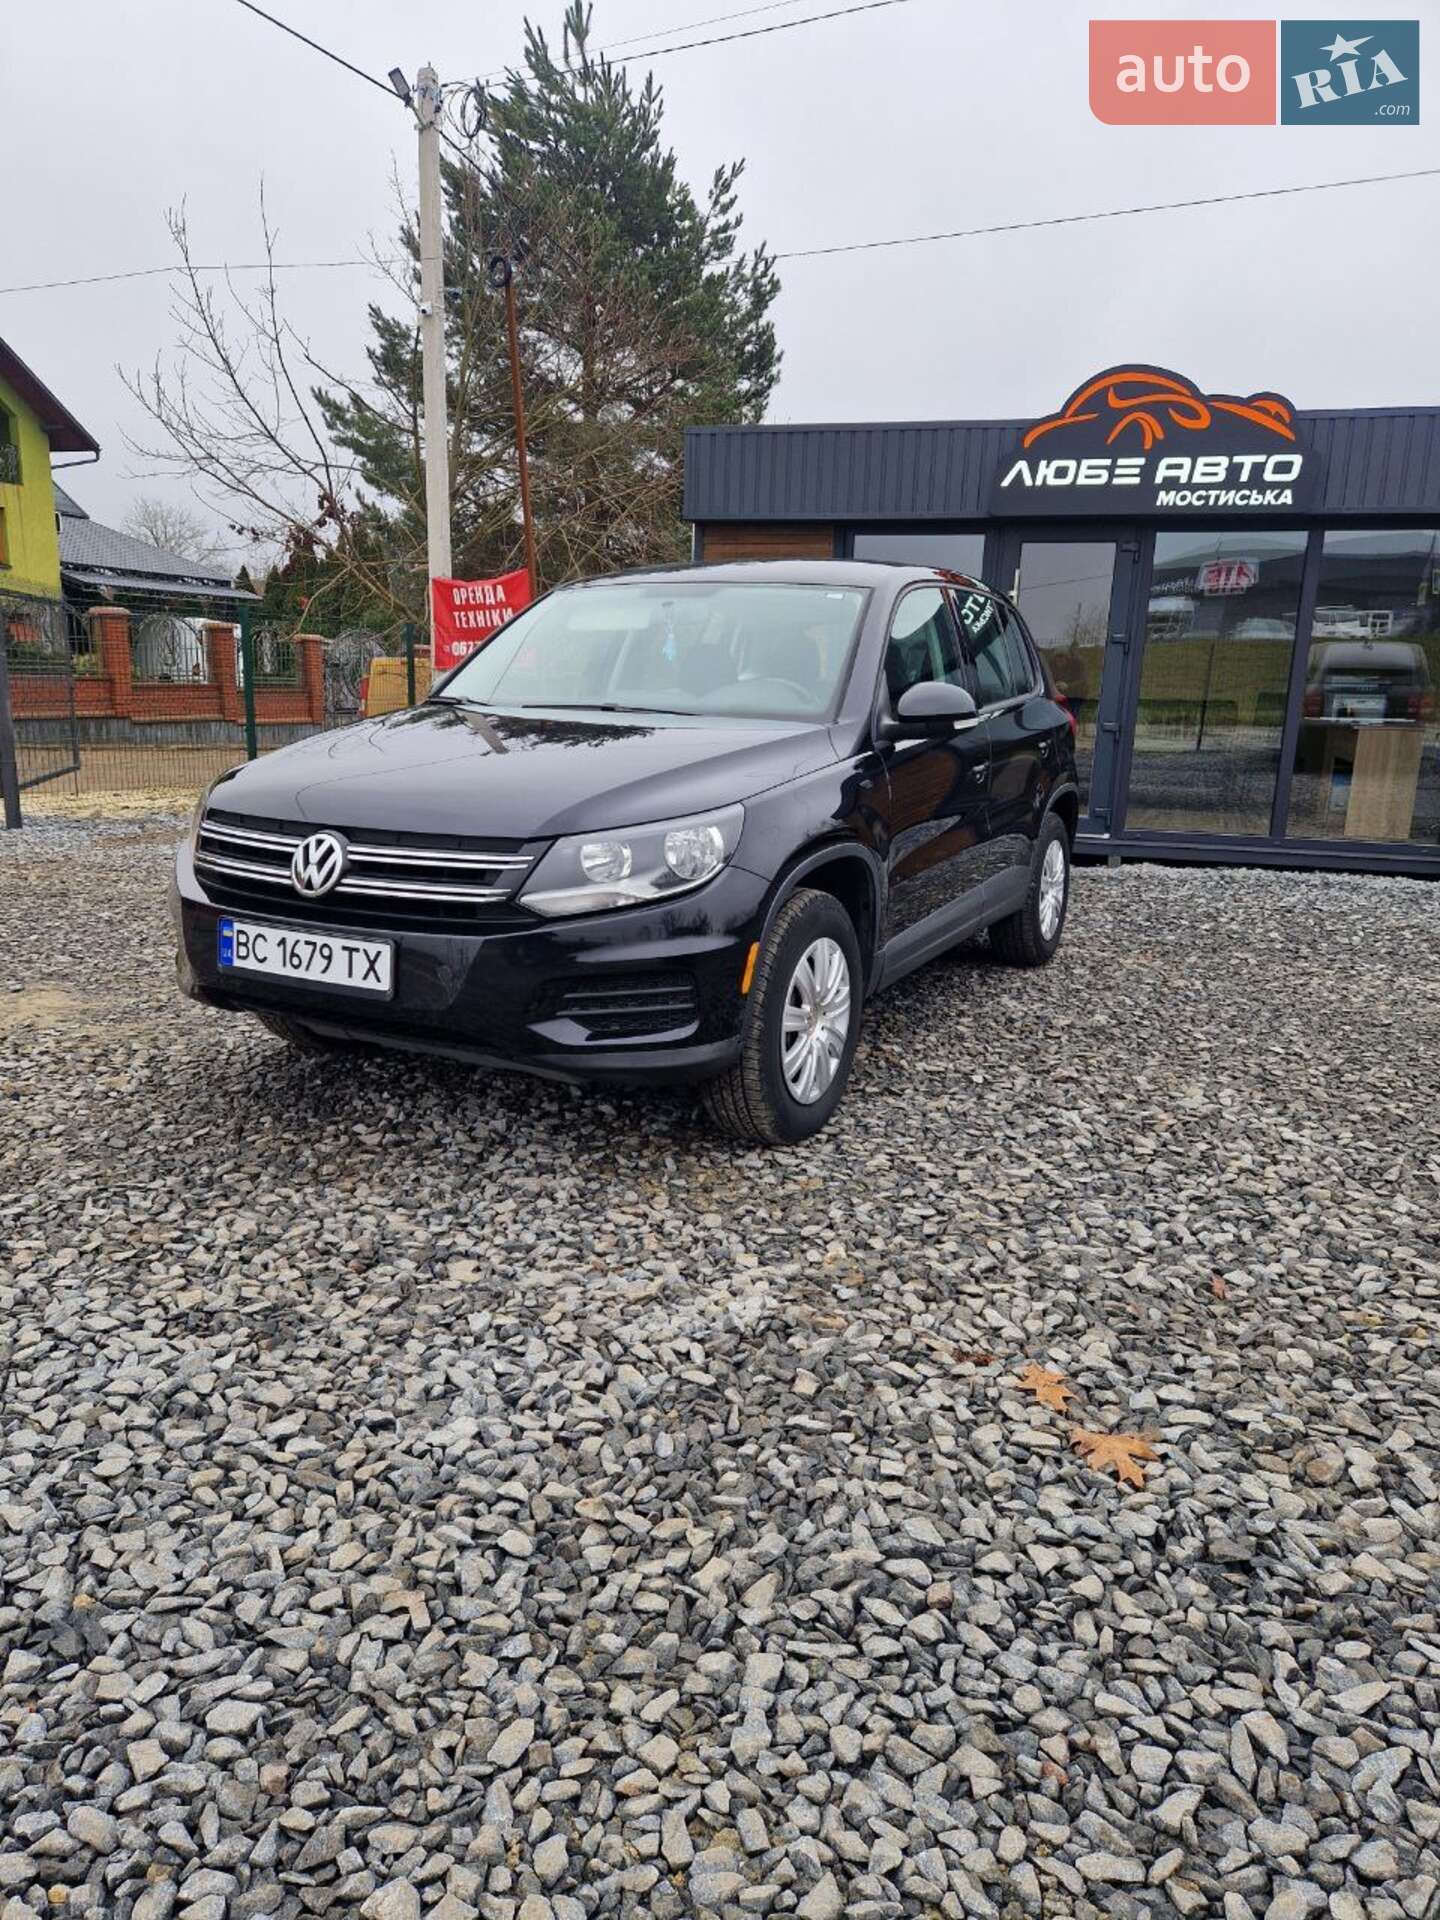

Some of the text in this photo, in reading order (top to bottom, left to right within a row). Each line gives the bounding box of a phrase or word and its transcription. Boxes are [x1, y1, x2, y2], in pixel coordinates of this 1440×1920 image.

[1000, 454, 1303, 487] ЛЮБЕ АВТО
[1155, 489, 1294, 506] МОСТИСЬКА
[452, 585, 506, 605] ОРЕНДА
[453, 607, 514, 628] ТЕХНІКИ
[236, 929, 383, 983] BC 1679 TX
